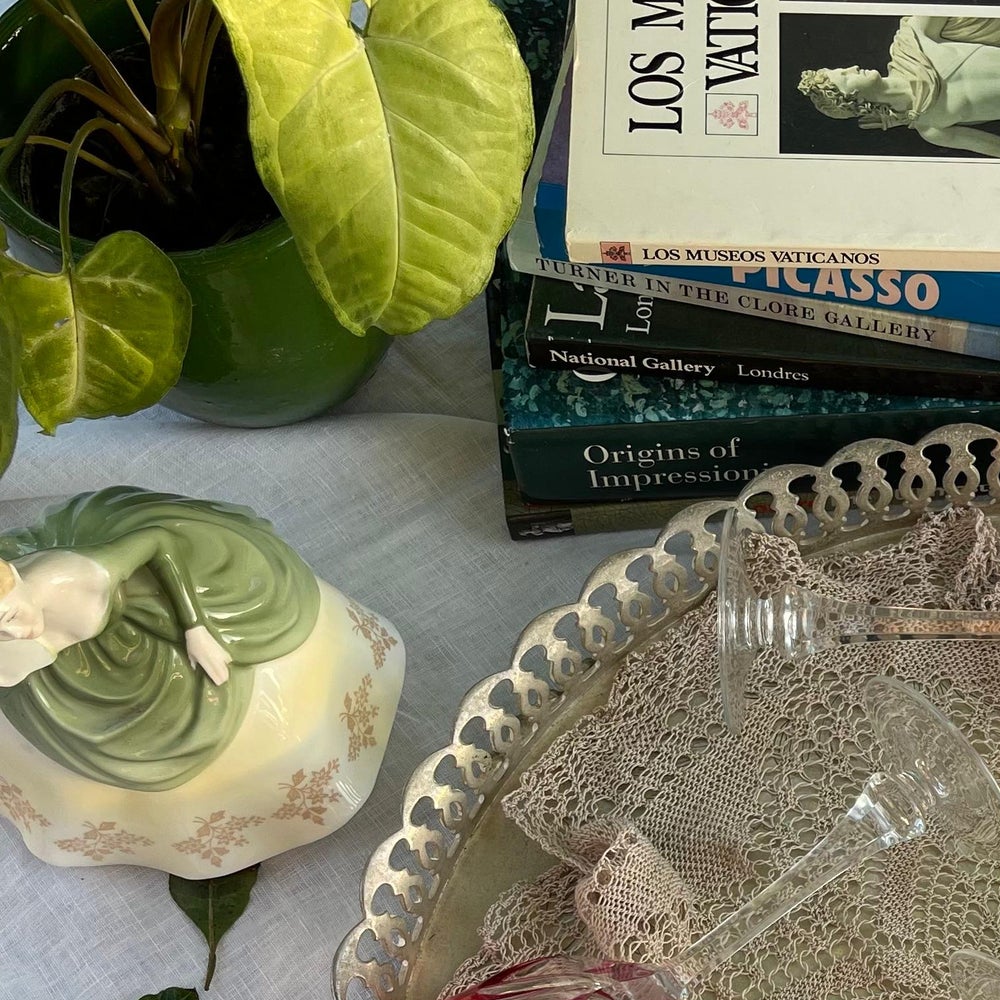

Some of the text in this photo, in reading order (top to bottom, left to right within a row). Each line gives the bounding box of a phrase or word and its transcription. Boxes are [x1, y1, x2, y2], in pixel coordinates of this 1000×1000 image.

[705, 0, 759, 91] VATI
[628, 52, 685, 134] LOS
[642, 248, 880, 265] LOS MUSEOS VATICANOS
[535, 257, 937, 343] TURNER IN THE CLORE GALLERY
[544, 282, 609, 331] L
[549, 349, 810, 382] National Gallery Londres
[583, 436, 741, 469] Origins of
[587, 463, 769, 492] Impression
